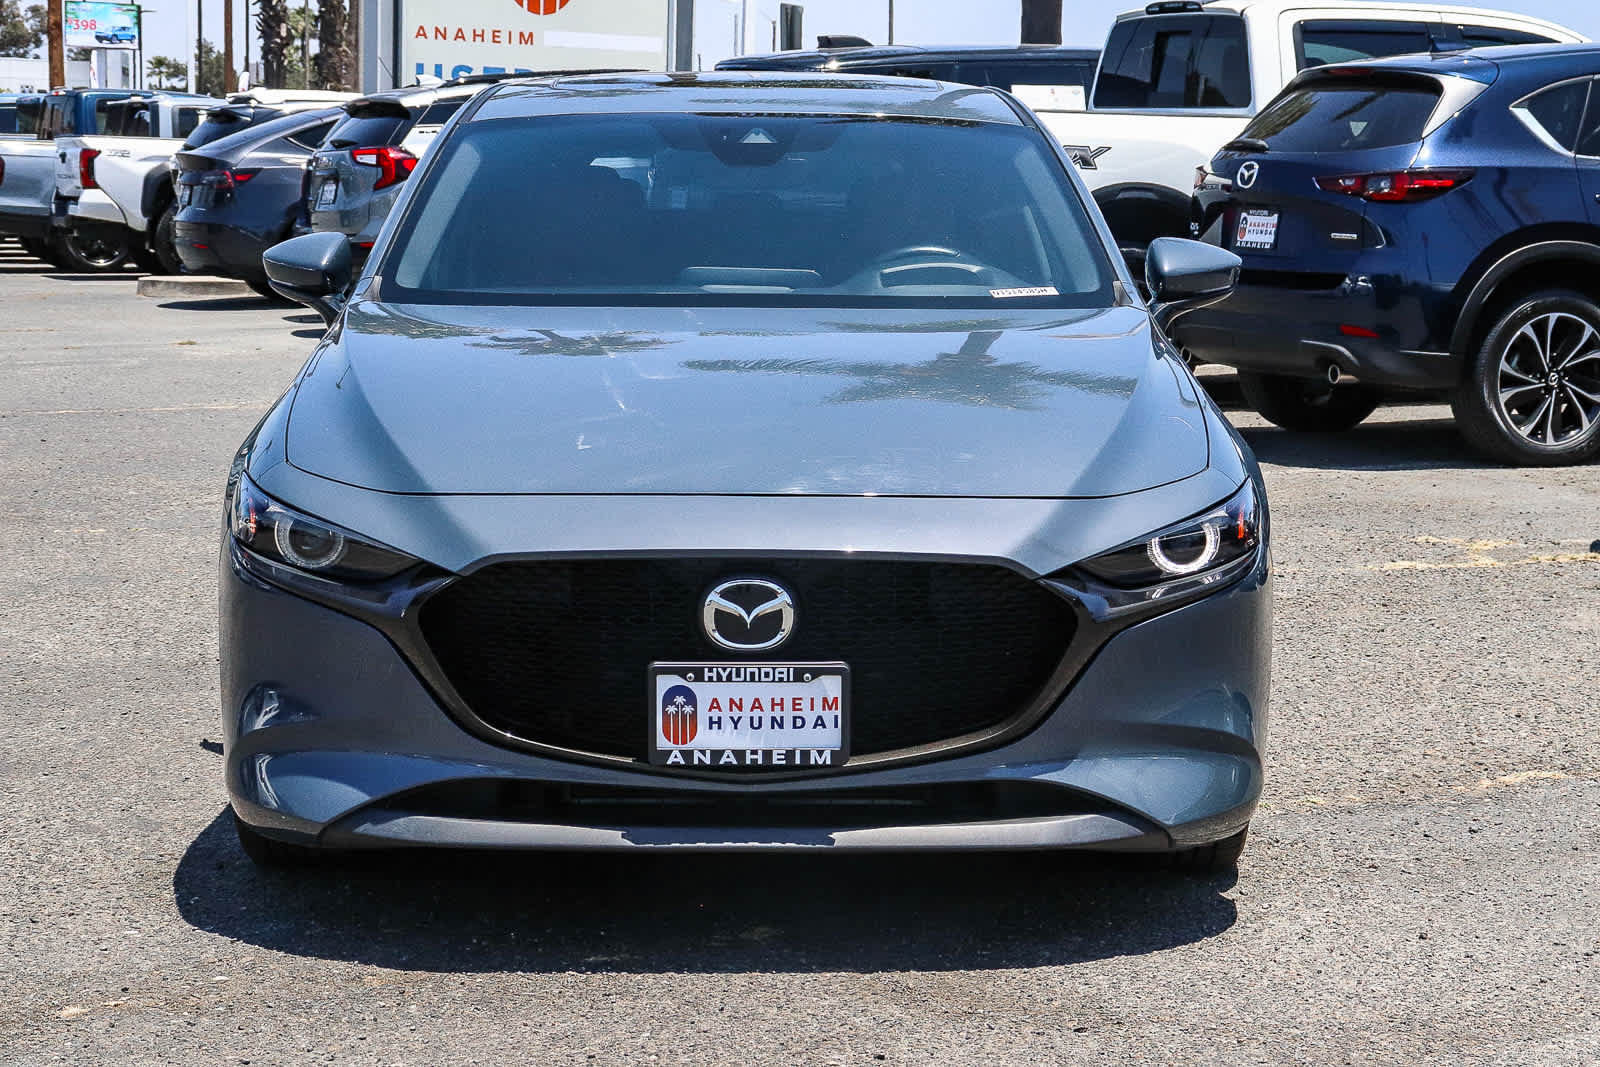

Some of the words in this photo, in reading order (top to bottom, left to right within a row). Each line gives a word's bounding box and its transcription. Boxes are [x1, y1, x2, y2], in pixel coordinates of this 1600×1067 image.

[414, 24, 535, 46] ANAHEIM
[704, 667, 794, 682] HYUNDAI
[707, 696, 839, 713] ANAHEIM
[708, 715, 839, 731] HYUNDAI
[665, 749, 832, 766] ANAHEIM
